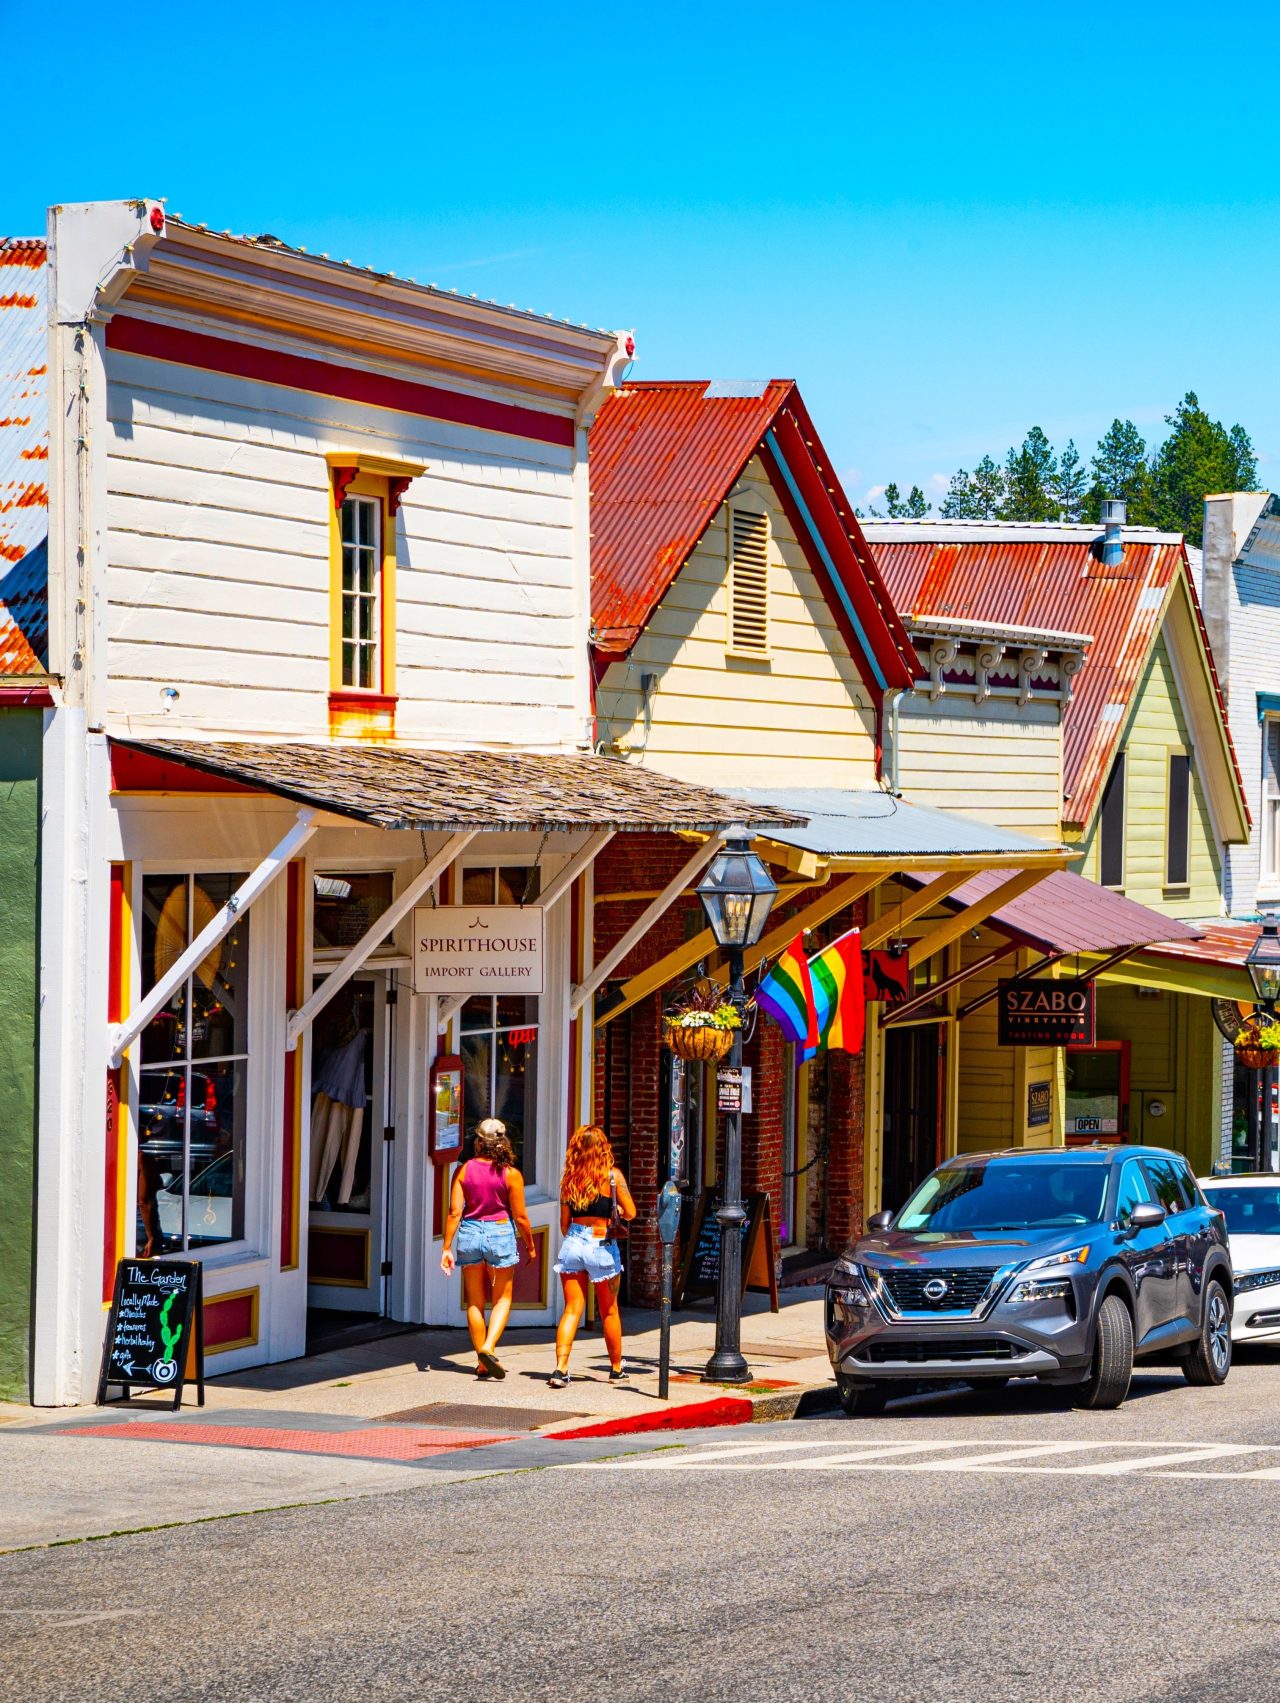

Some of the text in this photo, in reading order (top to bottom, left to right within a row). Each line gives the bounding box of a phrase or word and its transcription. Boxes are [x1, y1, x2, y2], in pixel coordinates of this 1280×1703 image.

[420, 938, 537, 953] SPIRITHOUSE
[425, 967, 532, 977] IMPORT GALLERY
[1007, 991, 1086, 1011] SZABO
[1056, 1032, 1085, 1040] ROOM
[1031, 1090, 1049, 1105] SZABO
[1077, 1118, 1100, 1130] OPEN
[127, 1266, 187, 1287] The Garden
